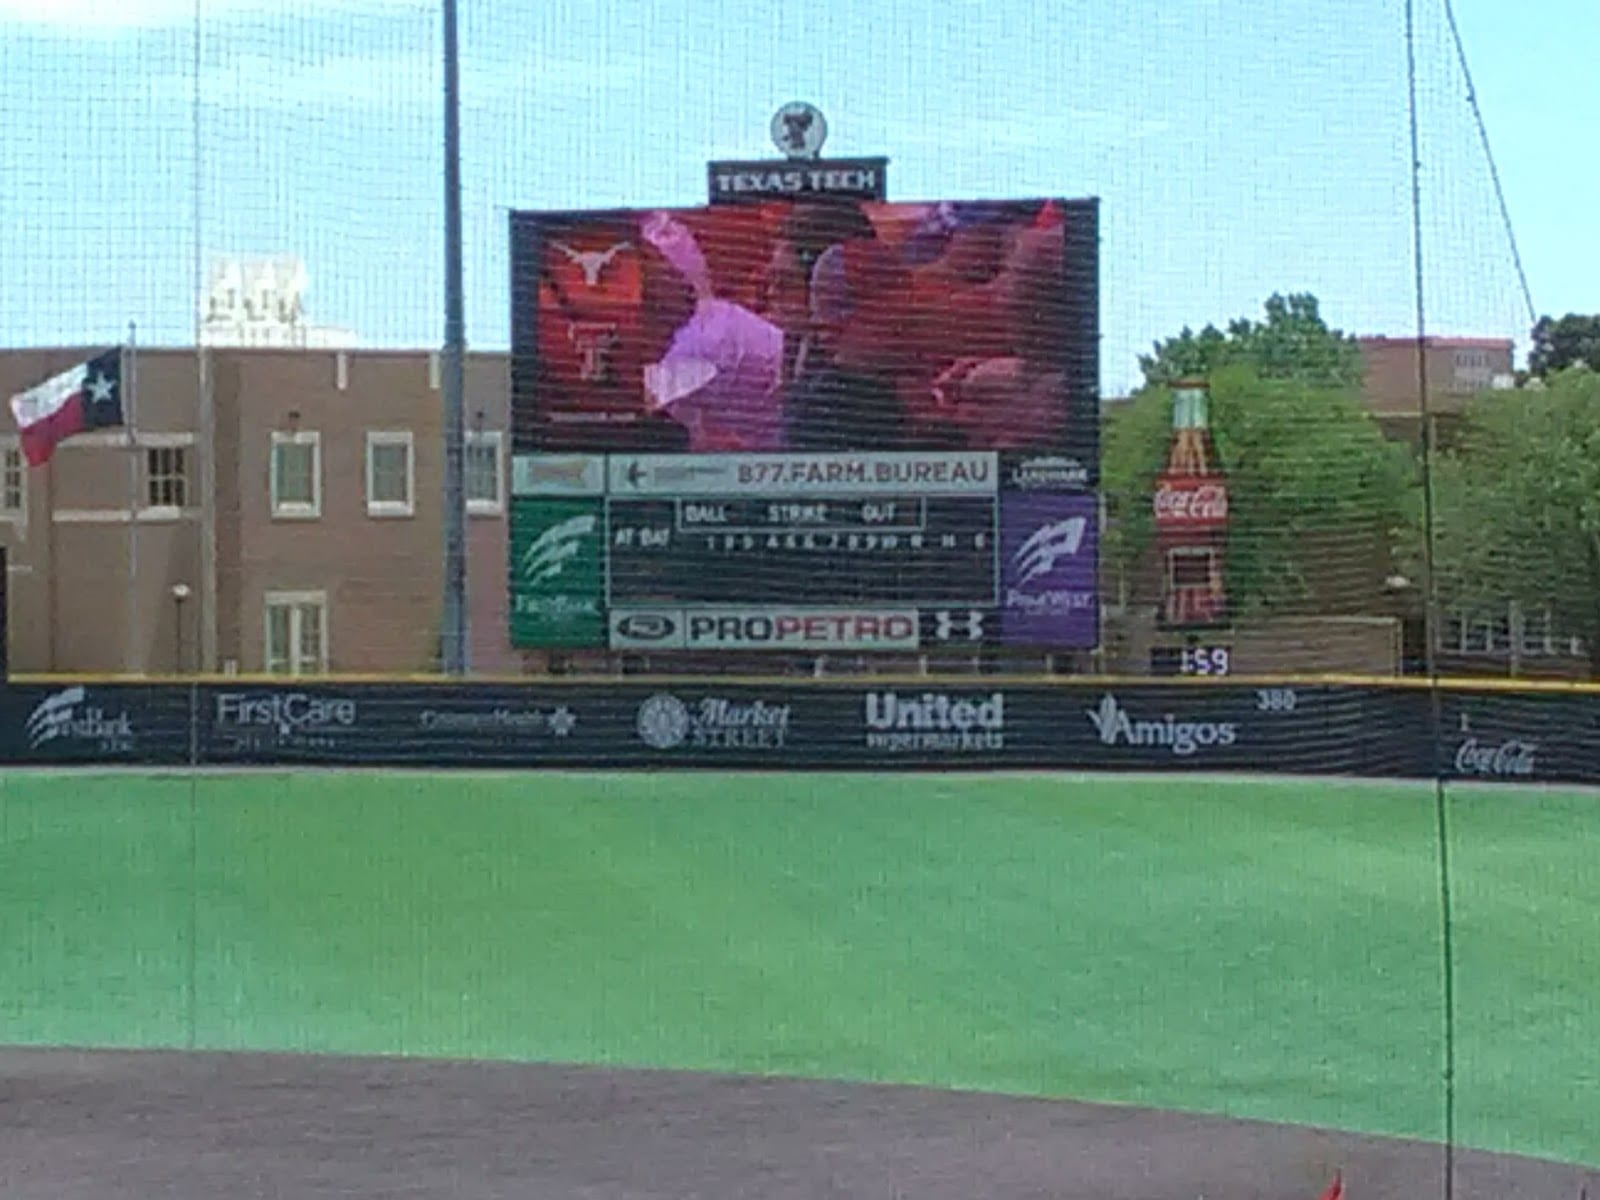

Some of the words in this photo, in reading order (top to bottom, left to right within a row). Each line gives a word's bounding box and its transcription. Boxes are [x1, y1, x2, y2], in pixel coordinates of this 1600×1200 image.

[716, 172, 801, 192] TEXAS
[807, 170, 875, 190] TECH
[685, 504, 728, 522] BALL
[767, 504, 828, 522] STRIKE
[862, 502, 896, 522] OUT
[614, 529, 634, 546] AT
[639, 528, 671, 546] BAT
[690, 615, 914, 642] PROPETRO
[217, 692, 356, 724] FirstCare
[699, 697, 792, 728] Market
[865, 693, 1004, 729] United
[691, 727, 789, 749] STREET
[1114, 708, 1237, 755] Amigos
